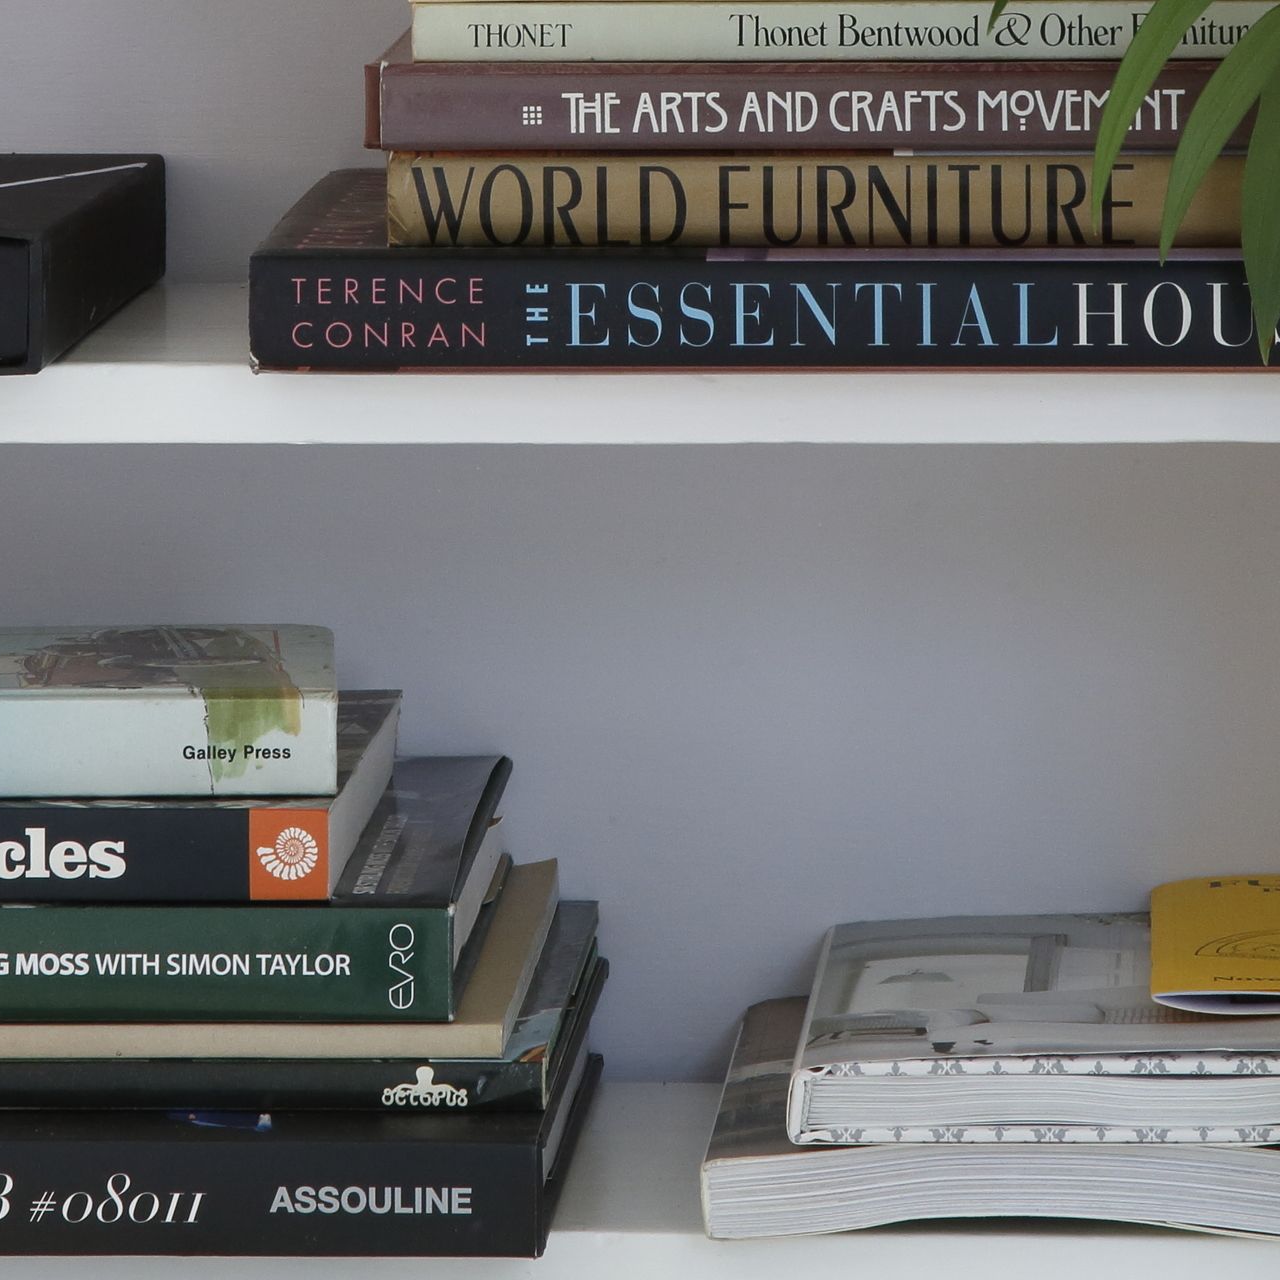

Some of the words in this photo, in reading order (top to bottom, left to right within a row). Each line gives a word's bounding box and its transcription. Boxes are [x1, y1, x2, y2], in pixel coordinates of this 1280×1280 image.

[466, 22, 573, 48] THONET
[728, 13, 829, 48] Thonet
[837, 12, 980, 48] Bentwood
[994, 12, 1033, 47] &
[1039, 12, 1124, 48] Other
[561, 91, 621, 134] THE
[631, 90, 729, 134] ARTS
[737, 90, 819, 133] AND
[827, 89, 967, 133] CRAFTS
[977, 87, 1187, 133] MOVEMNT
[410, 163, 689, 247] WORLD
[719, 163, 1136, 248] FURNITURE
[290, 277, 486, 306] TERENCE
[525, 282, 550, 347] THE
[291, 320, 488, 349] CONRAN
[182, 744, 238, 763] Galley
[243, 745, 292, 761] Press
[15, 953, 89, 977] MOSS
[94, 953, 162, 977] WITH
[166, 953, 250, 977] SIMON
[254, 953, 352, 977] TAYLOR
[268, 1185, 474, 1216] ASSOULINE
